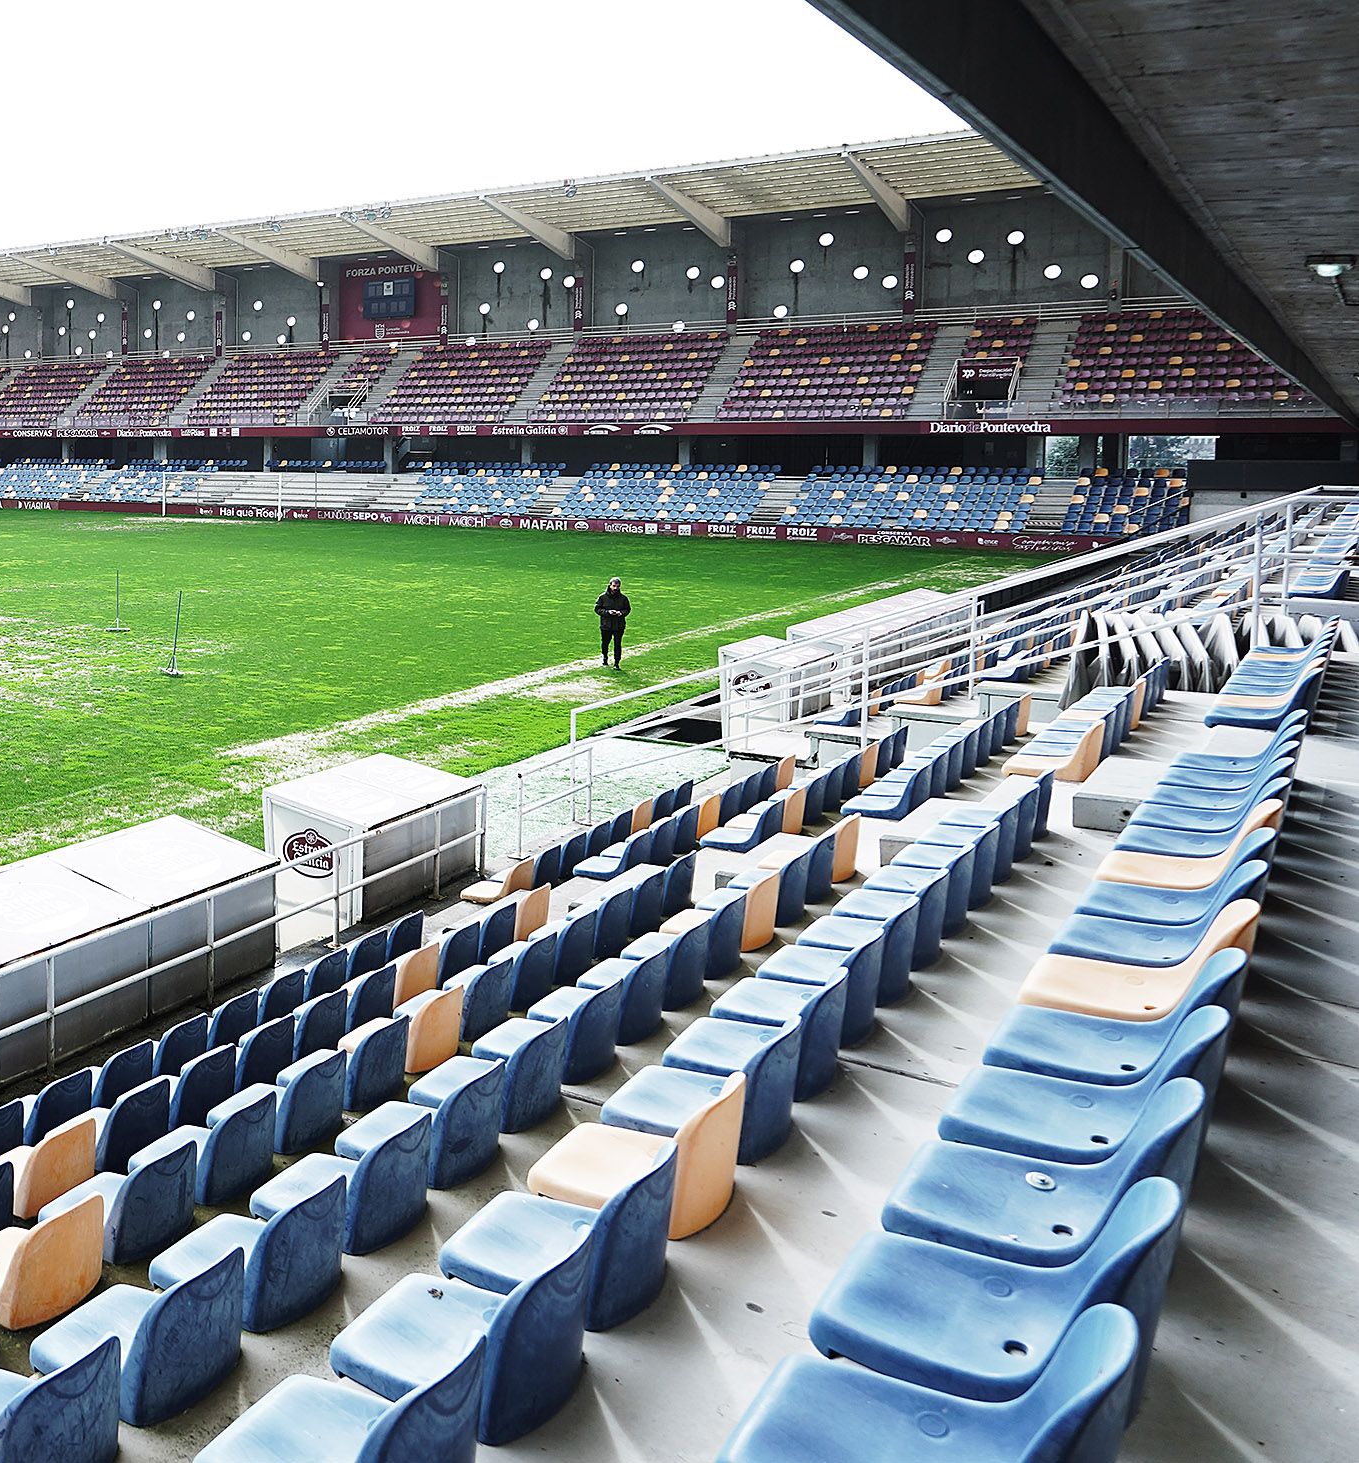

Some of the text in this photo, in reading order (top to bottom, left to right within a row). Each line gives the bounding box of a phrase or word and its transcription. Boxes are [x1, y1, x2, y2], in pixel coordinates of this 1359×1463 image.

[346, 267, 376, 278] FORZA
[13, 429, 52, 438] CONSERVAS
[337, 427, 388, 435] CELTAMOTOR
[492, 425, 557, 435] Estrella Galicia
[220, 507, 234, 516] Hai
[236, 509, 254, 518] que
[519, 519, 567, 531] MAFARI
[708, 525, 736, 533] FROIZ
[746, 525, 776, 534] FROIZ
[786, 528, 817, 537] FROIZ
[858, 533, 931, 546] PESCAMAR
